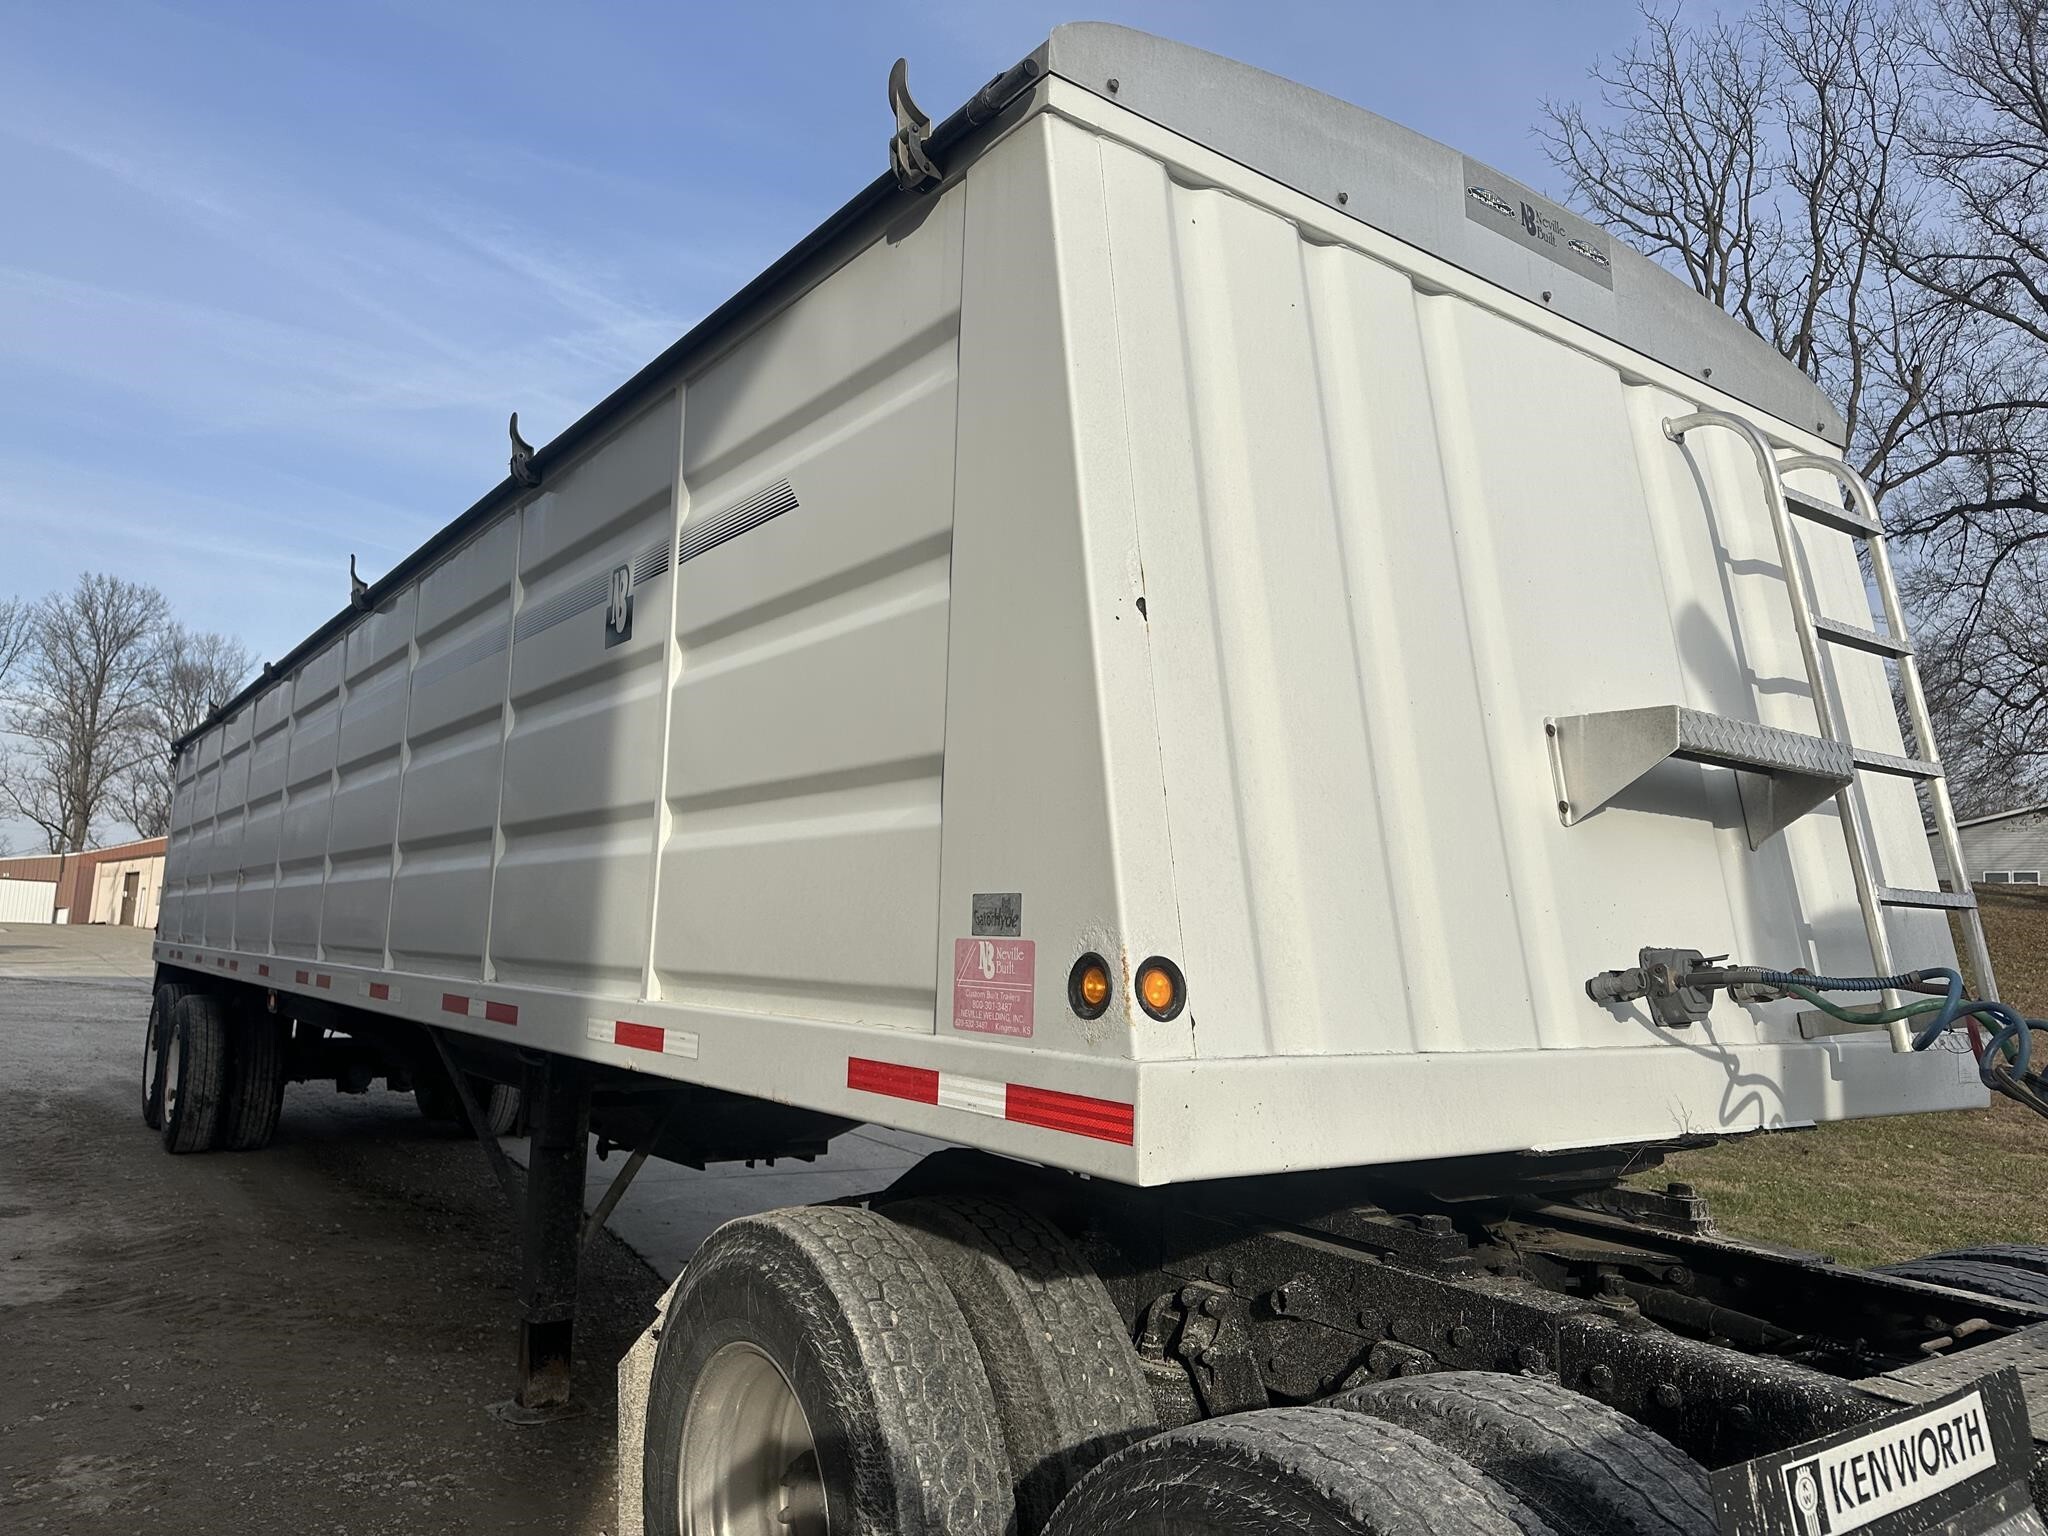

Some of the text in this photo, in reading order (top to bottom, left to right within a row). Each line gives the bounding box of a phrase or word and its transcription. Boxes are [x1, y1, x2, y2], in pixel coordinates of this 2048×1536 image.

[1536, 211, 1566, 237] Neville
[1537, 226, 1558, 248] Built
[996, 947, 1025, 961] Neville
[996, 961, 1016, 975] Built
[965, 989, 1020, 1002] Custom Built Trailers
[960, 1009, 983, 1019] NEVILLE
[1022, 1026, 1031, 1035] KS
[1829, 1408, 1986, 1514] KENWORTH
